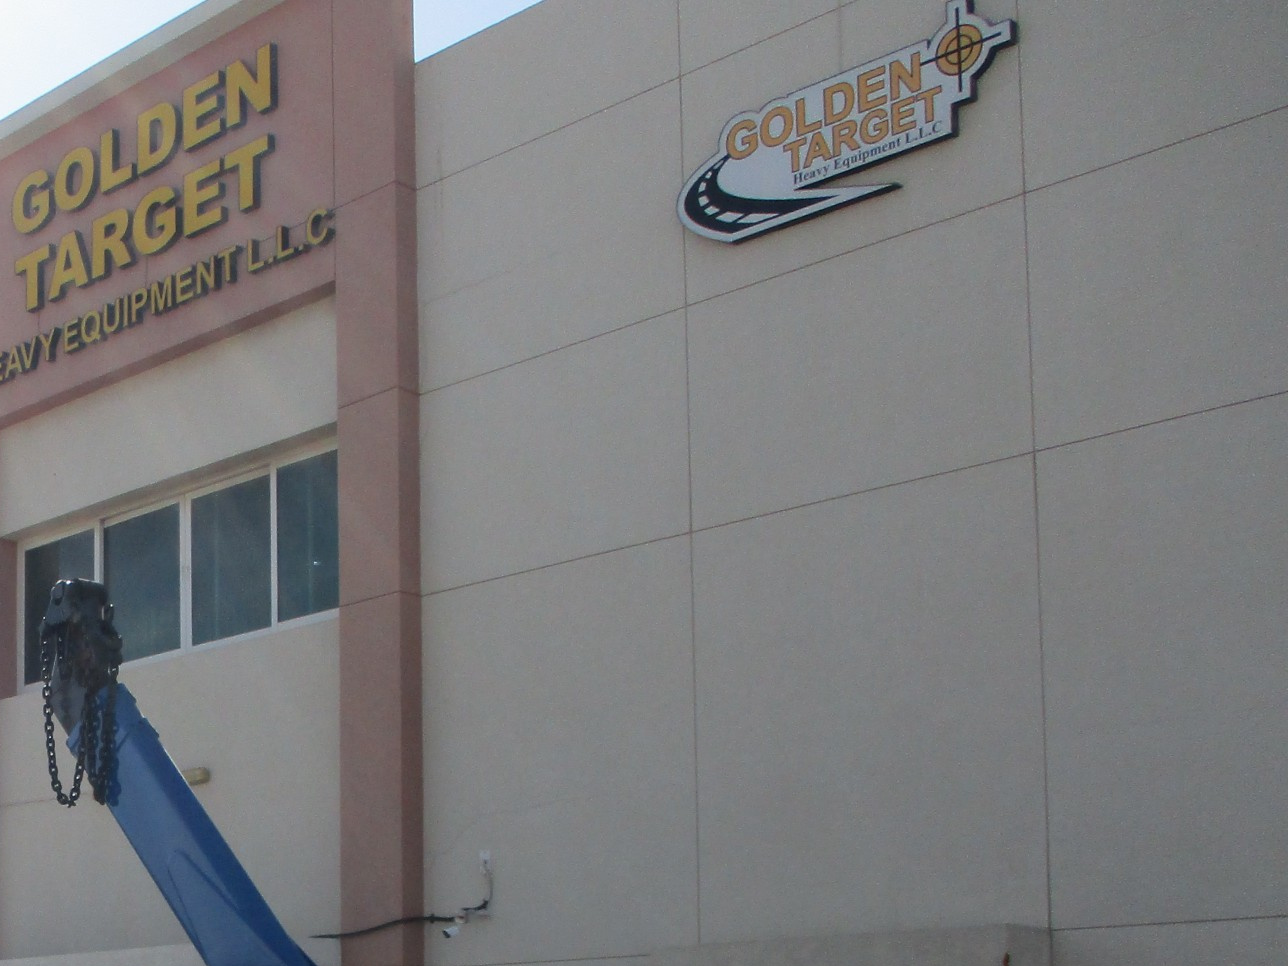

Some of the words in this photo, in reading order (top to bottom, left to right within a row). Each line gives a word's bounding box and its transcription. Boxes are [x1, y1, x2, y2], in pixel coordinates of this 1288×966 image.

[12, 42, 278, 237] GOLDEN
[726, 52, 922, 160] GOLDEN
[783, 85, 943, 173] TARGET
[793, 163, 831, 185] Heavy
[834, 138, 902, 170] Equipment
[15, 133, 276, 313] TARGET
[64, 246, 243, 355] EQUIPMENT
[246, 208, 337, 274] L.L.C
